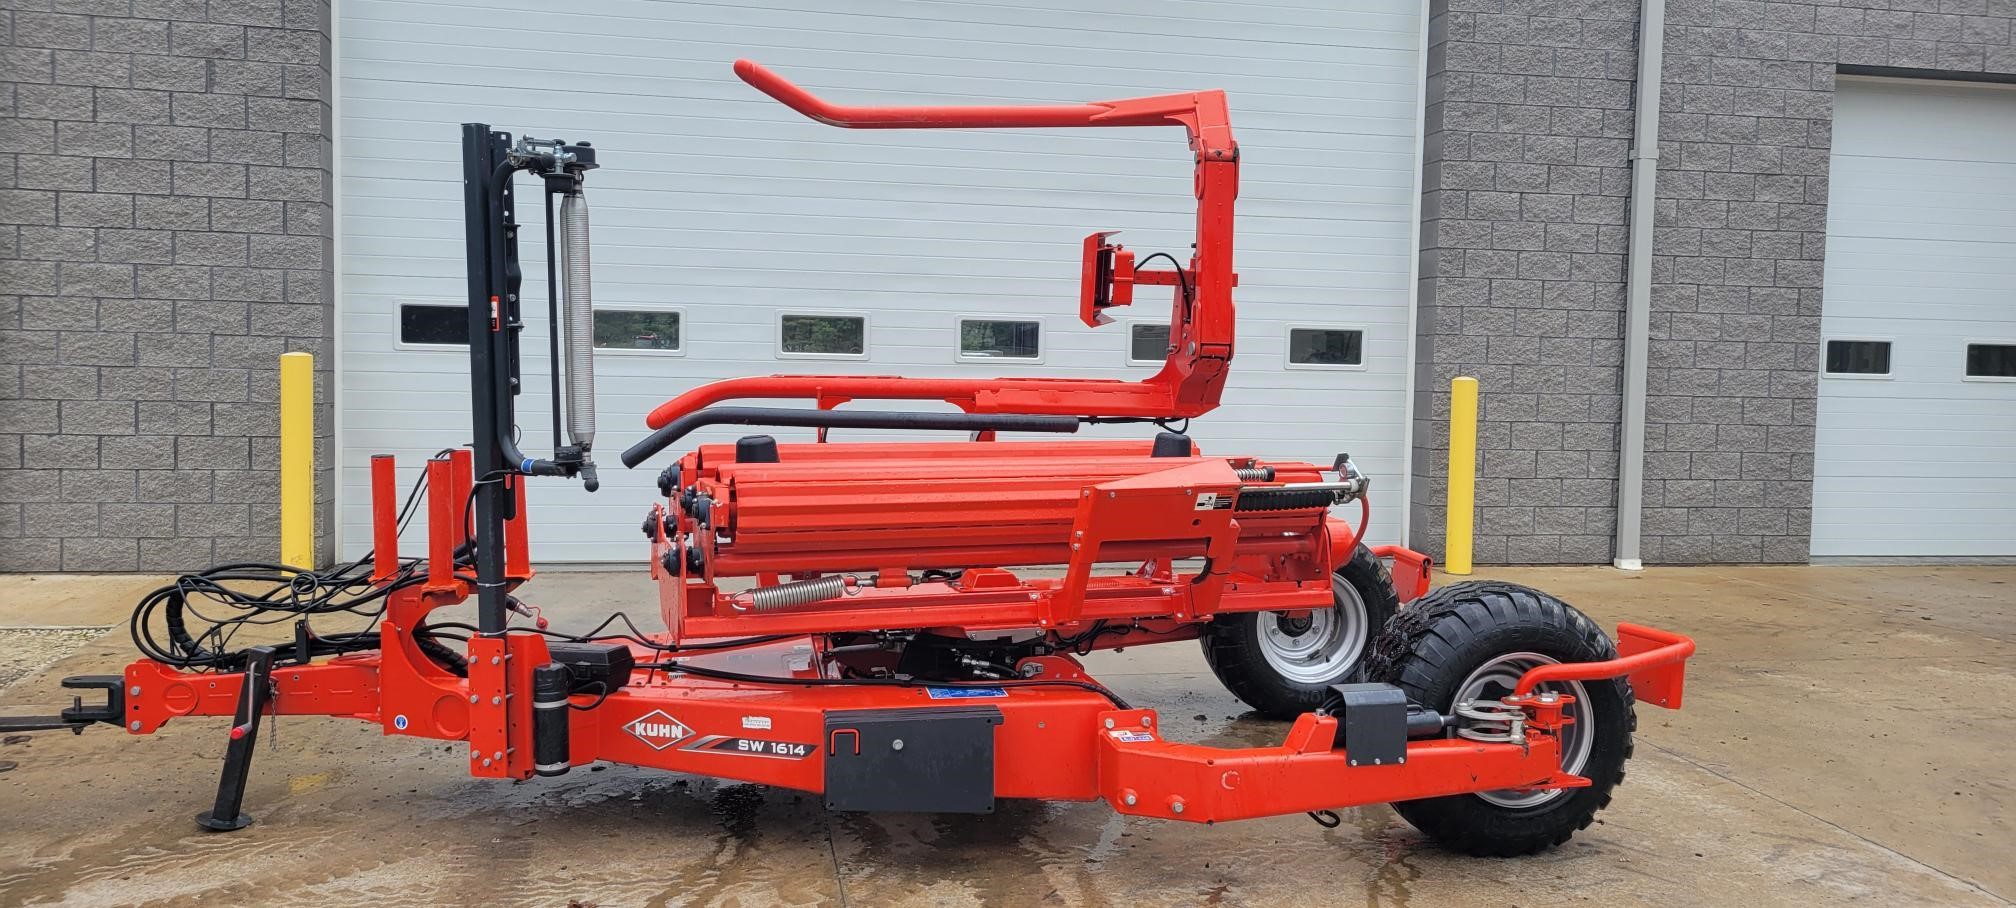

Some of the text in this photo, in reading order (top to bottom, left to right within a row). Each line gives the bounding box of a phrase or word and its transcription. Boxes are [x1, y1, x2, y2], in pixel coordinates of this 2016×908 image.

[635, 722, 683, 739] KUHN
[738, 739, 805, 756] SW 1614
